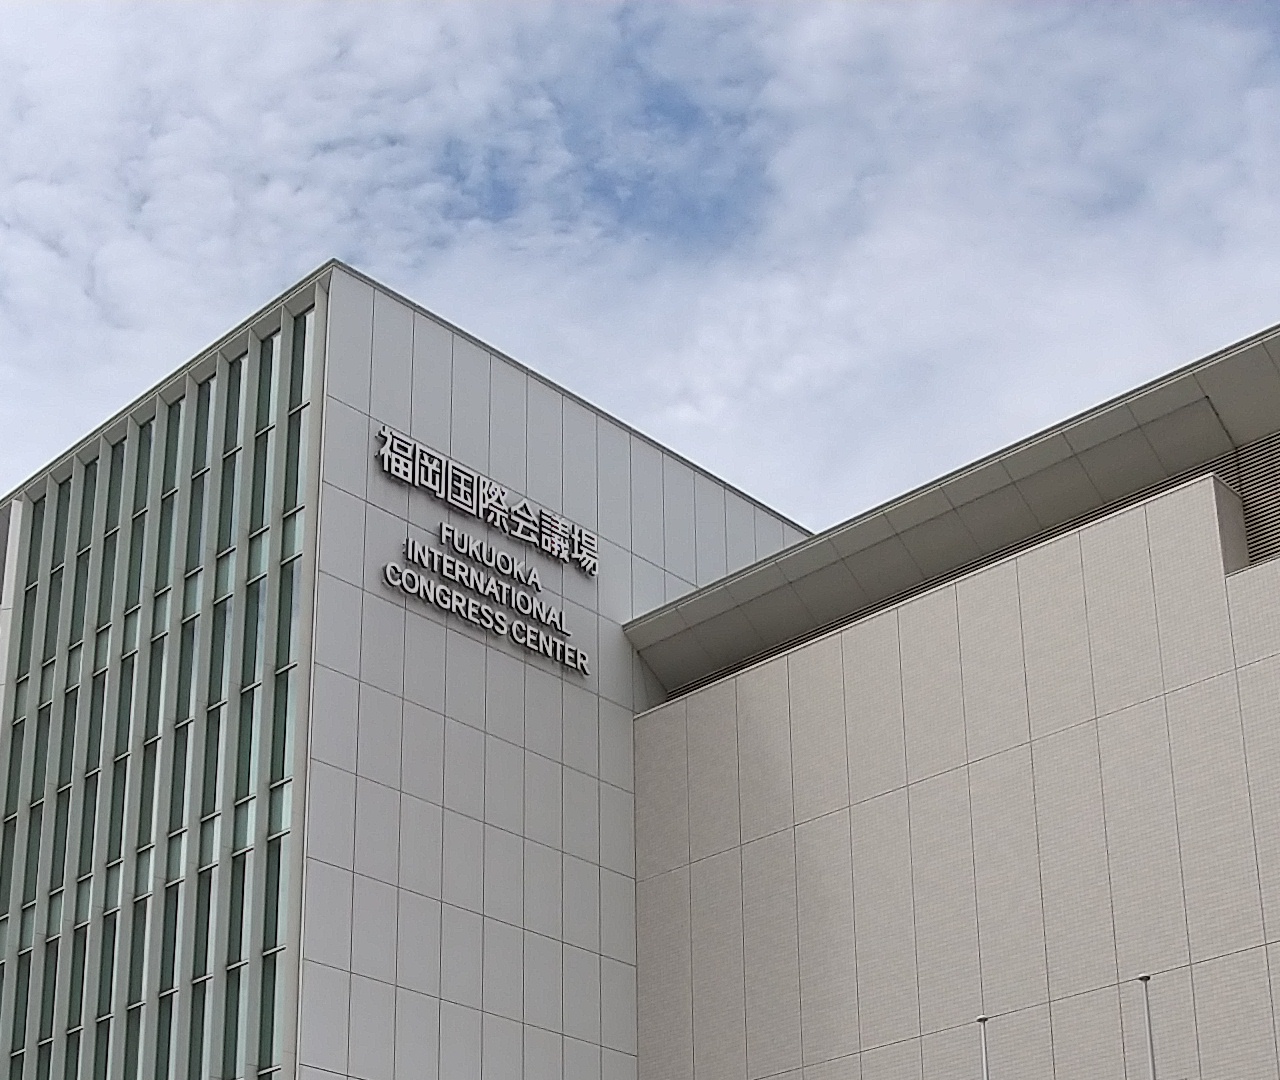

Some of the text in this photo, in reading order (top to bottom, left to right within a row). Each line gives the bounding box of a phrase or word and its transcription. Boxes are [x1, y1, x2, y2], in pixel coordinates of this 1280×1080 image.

[376, 425, 599, 577] 福岡国際会議場
[405, 537, 572, 637] INTERNATIONAL
[440, 521, 543, 591] FUKUOKA
[385, 561, 591, 676] CONGRESS CENTER
